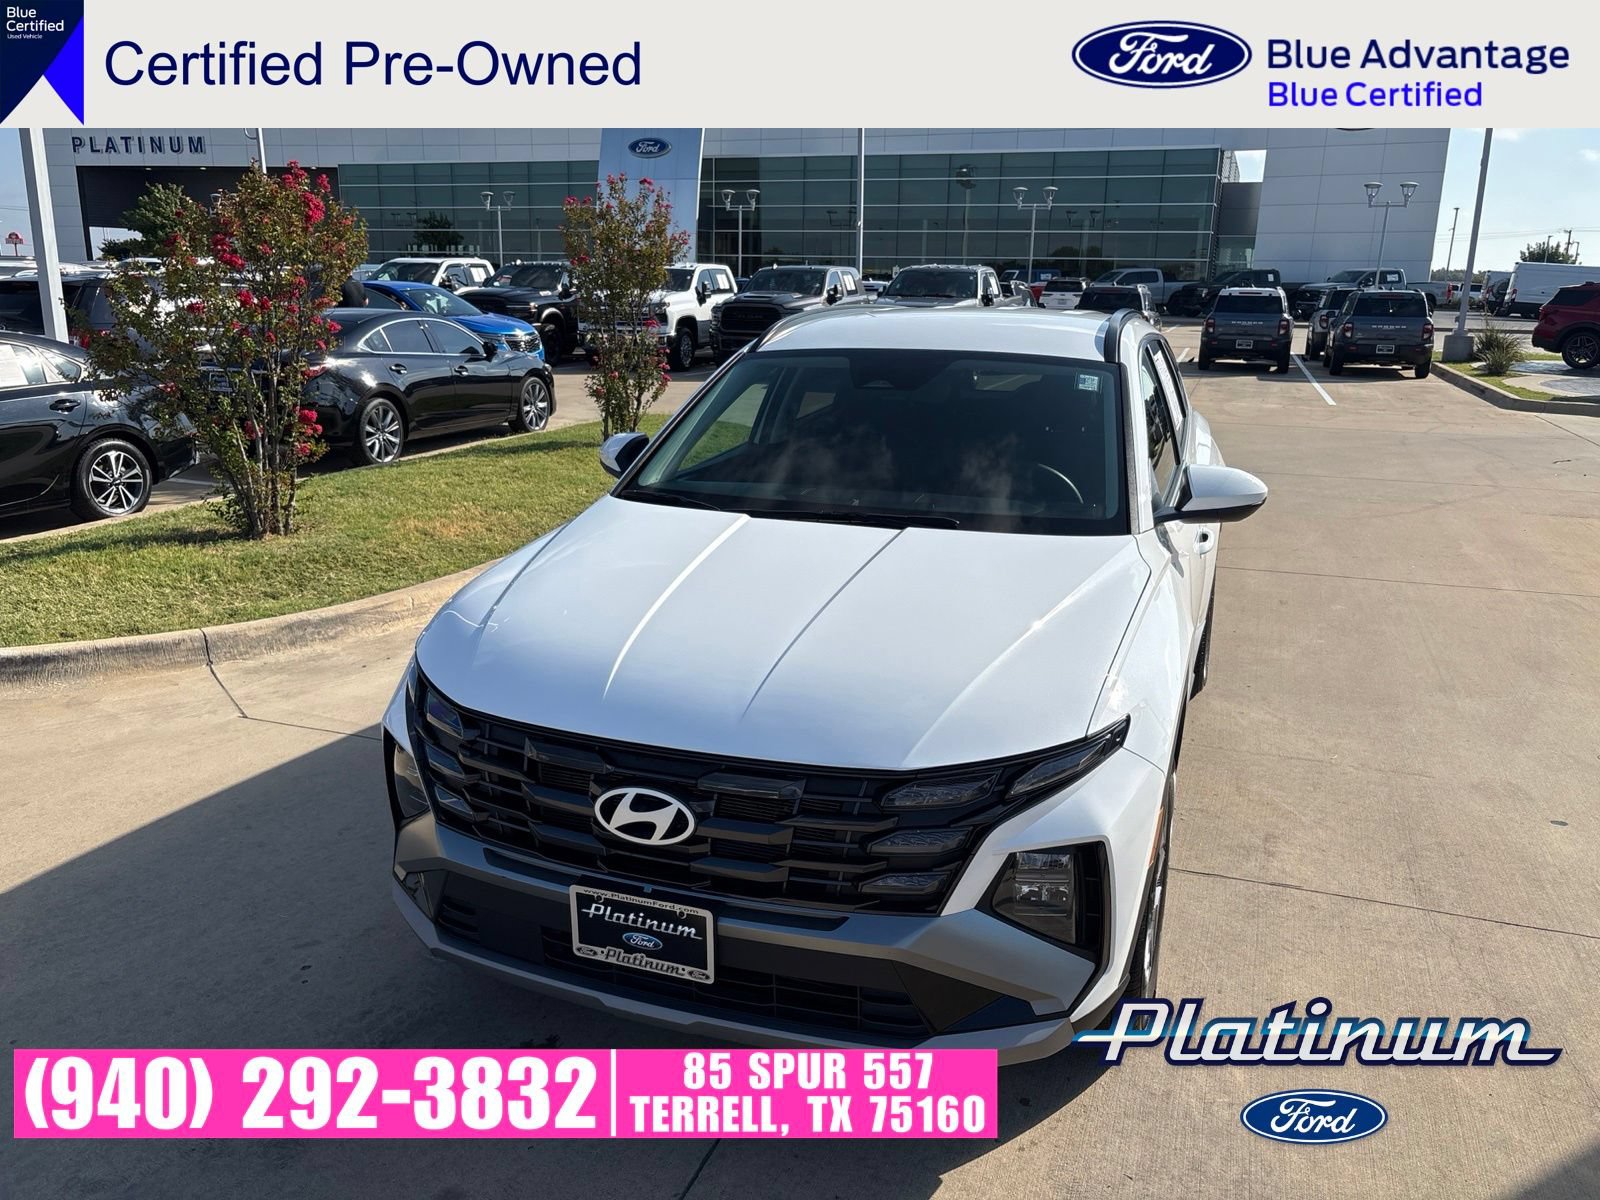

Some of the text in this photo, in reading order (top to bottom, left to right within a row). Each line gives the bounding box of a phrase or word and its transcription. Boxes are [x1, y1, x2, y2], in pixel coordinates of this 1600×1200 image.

[71, 136, 206, 154] PLATINUM
[581, 903, 703, 940] Platinum
[630, 935, 655, 948] Ford
[604, 946, 685, 976] Platinum
